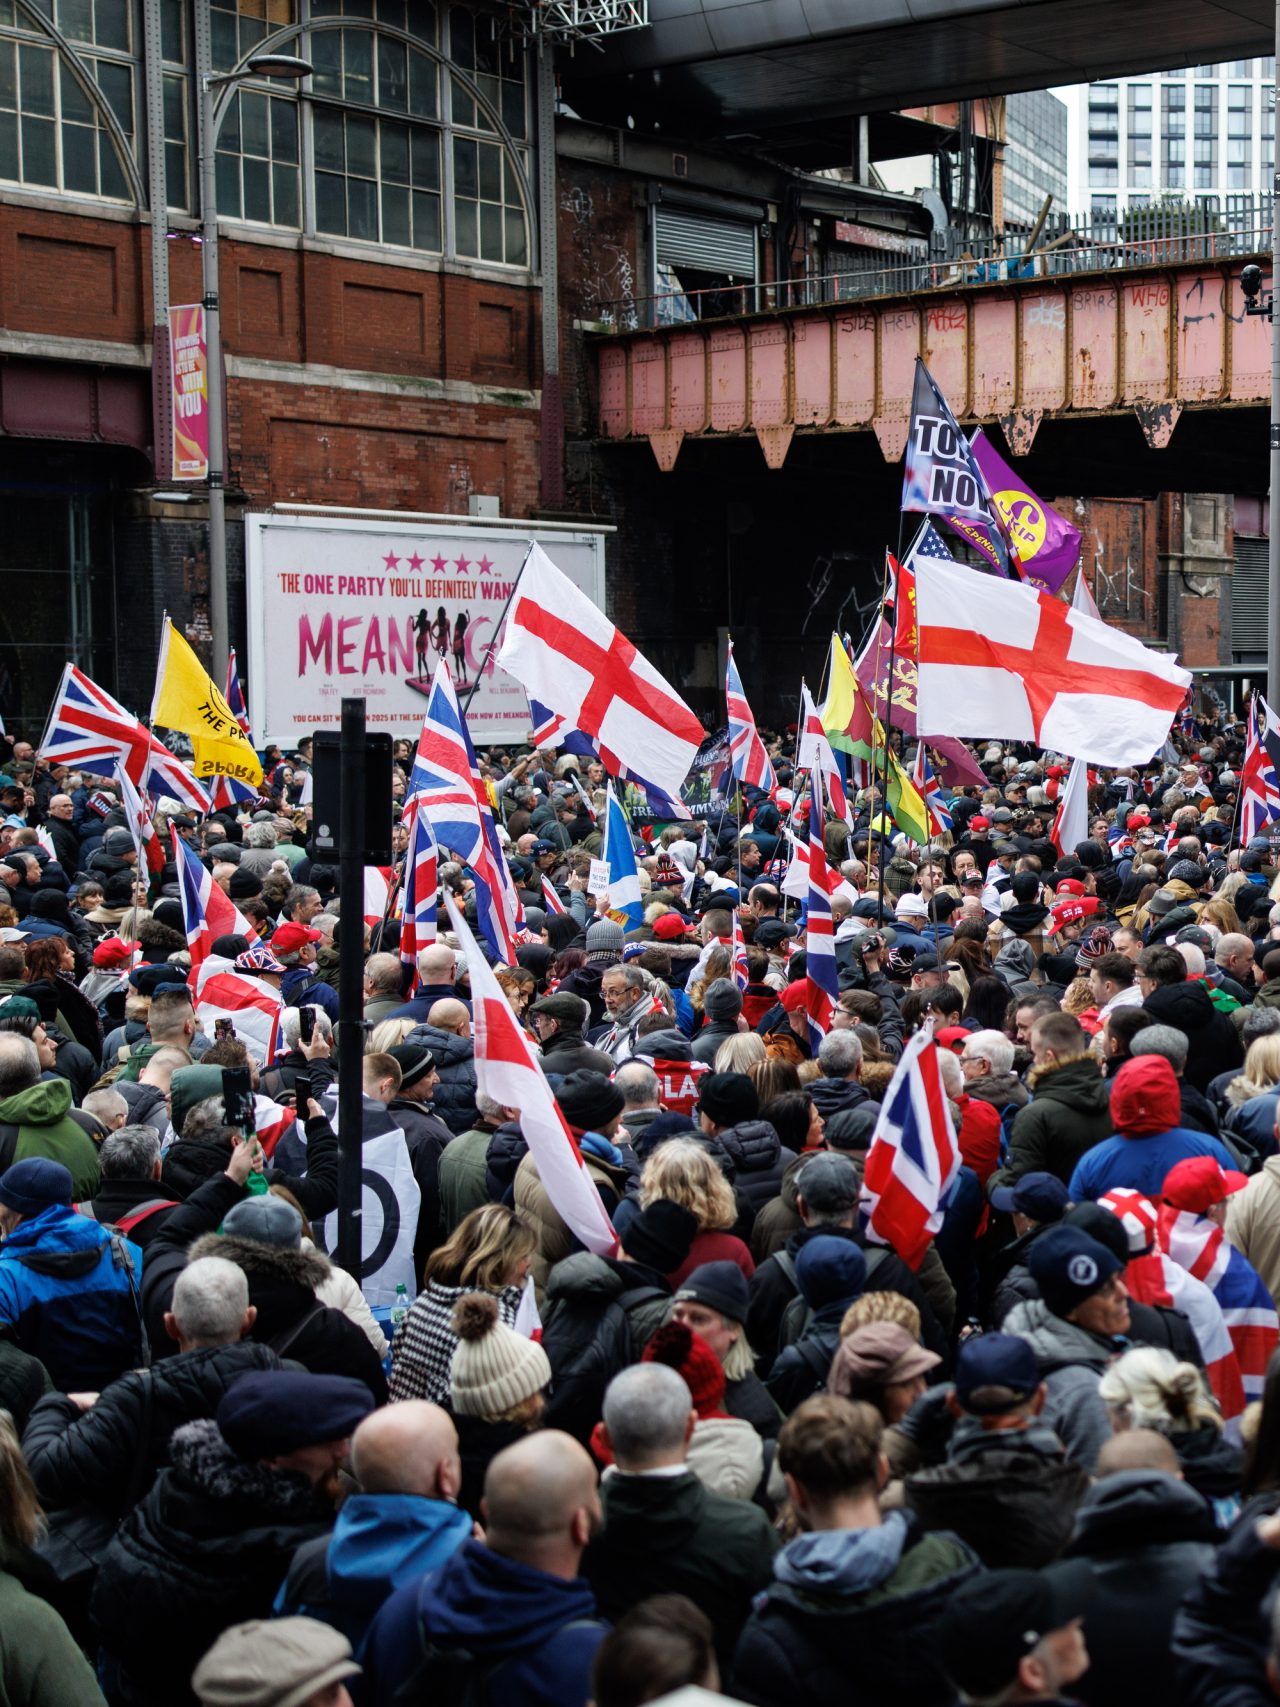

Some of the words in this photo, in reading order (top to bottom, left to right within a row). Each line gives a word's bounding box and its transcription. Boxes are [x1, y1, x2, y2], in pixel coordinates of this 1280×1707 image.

[178, 391, 202, 419] YOU
[304, 574, 334, 595] ONE
[338, 576, 385, 596] PARTY
[390, 578, 422, 598] YOU'LL
[426, 580, 477, 599] DEFINITELY
[481, 581, 515, 600] WAN
[299, 611, 414, 678] MEAN
[198, 702, 226, 731] THE
[323, 714, 333, 722] SIT
